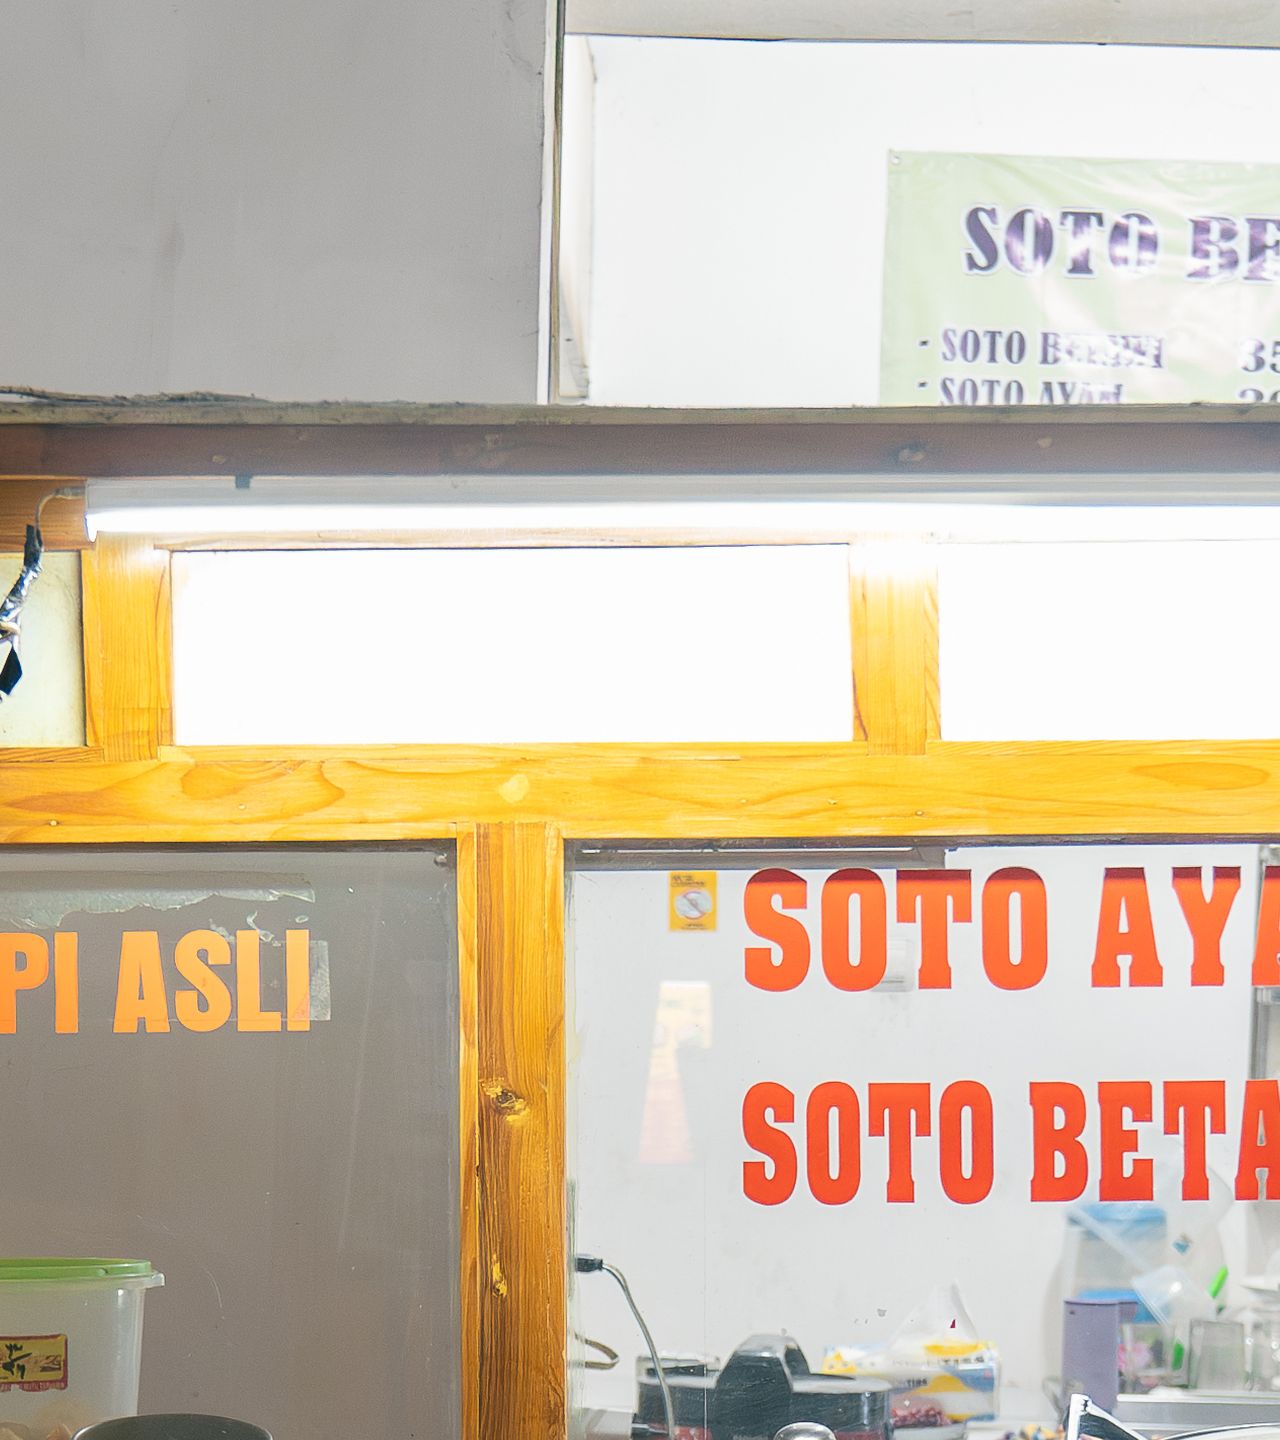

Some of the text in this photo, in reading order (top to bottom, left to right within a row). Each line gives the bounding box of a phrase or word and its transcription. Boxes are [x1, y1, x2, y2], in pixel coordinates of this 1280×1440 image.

[965, 205, 1159, 276] SOTO
[940, 328, 1027, 365] SOTO
[743, 865, 1048, 992] SOTO
[113, 929, 310, 1034] ASLI
[742, 1080, 994, 1205] SOTO
